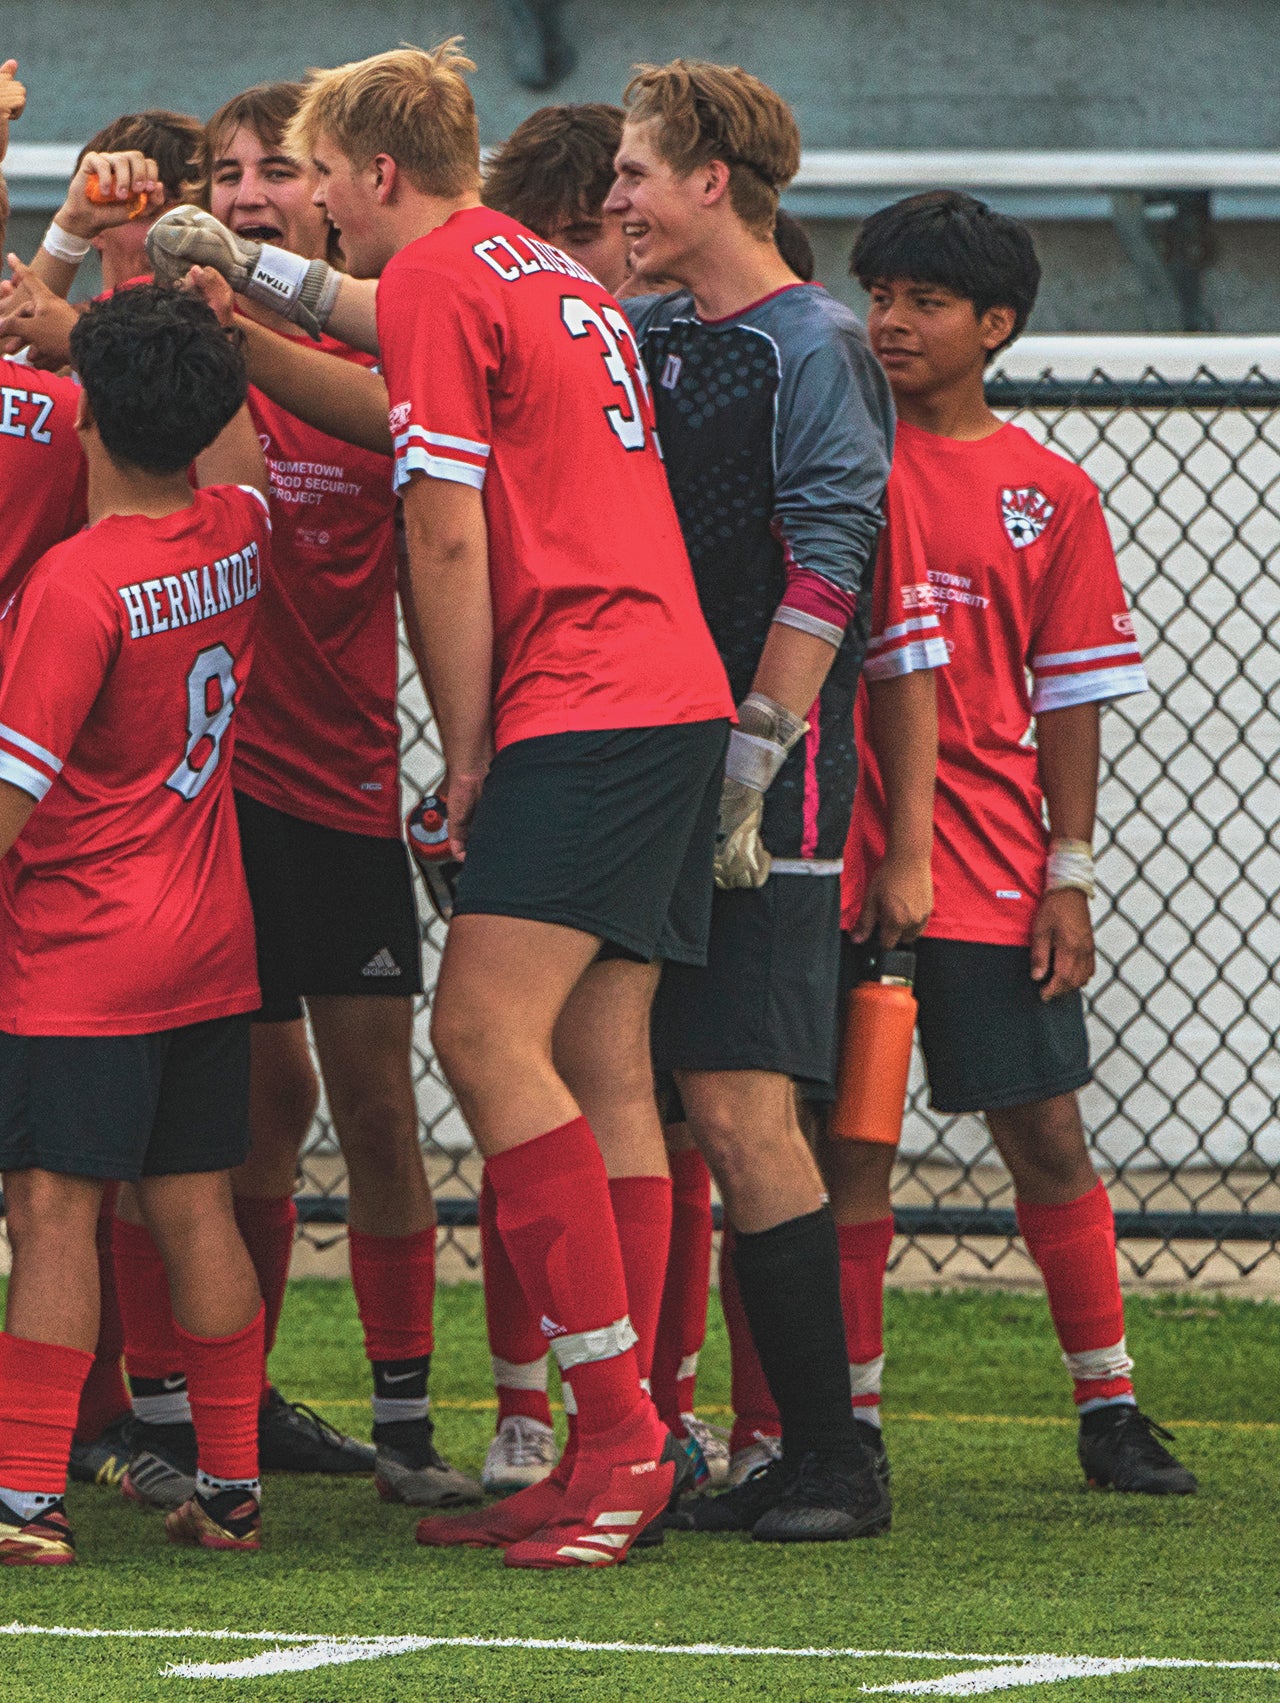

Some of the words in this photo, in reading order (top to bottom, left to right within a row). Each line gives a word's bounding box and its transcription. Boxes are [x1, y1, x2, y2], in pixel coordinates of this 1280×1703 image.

[256, 270, 290, 295] TITAN
[270, 460, 344, 478] HOMETOWN
[269, 487, 324, 505] PROJECT
[270, 471, 302, 489] FOOD
[305, 477, 362, 496] SECURITY
[118, 541, 261, 640] HERNANDE
[163, 642, 238, 800] 8
